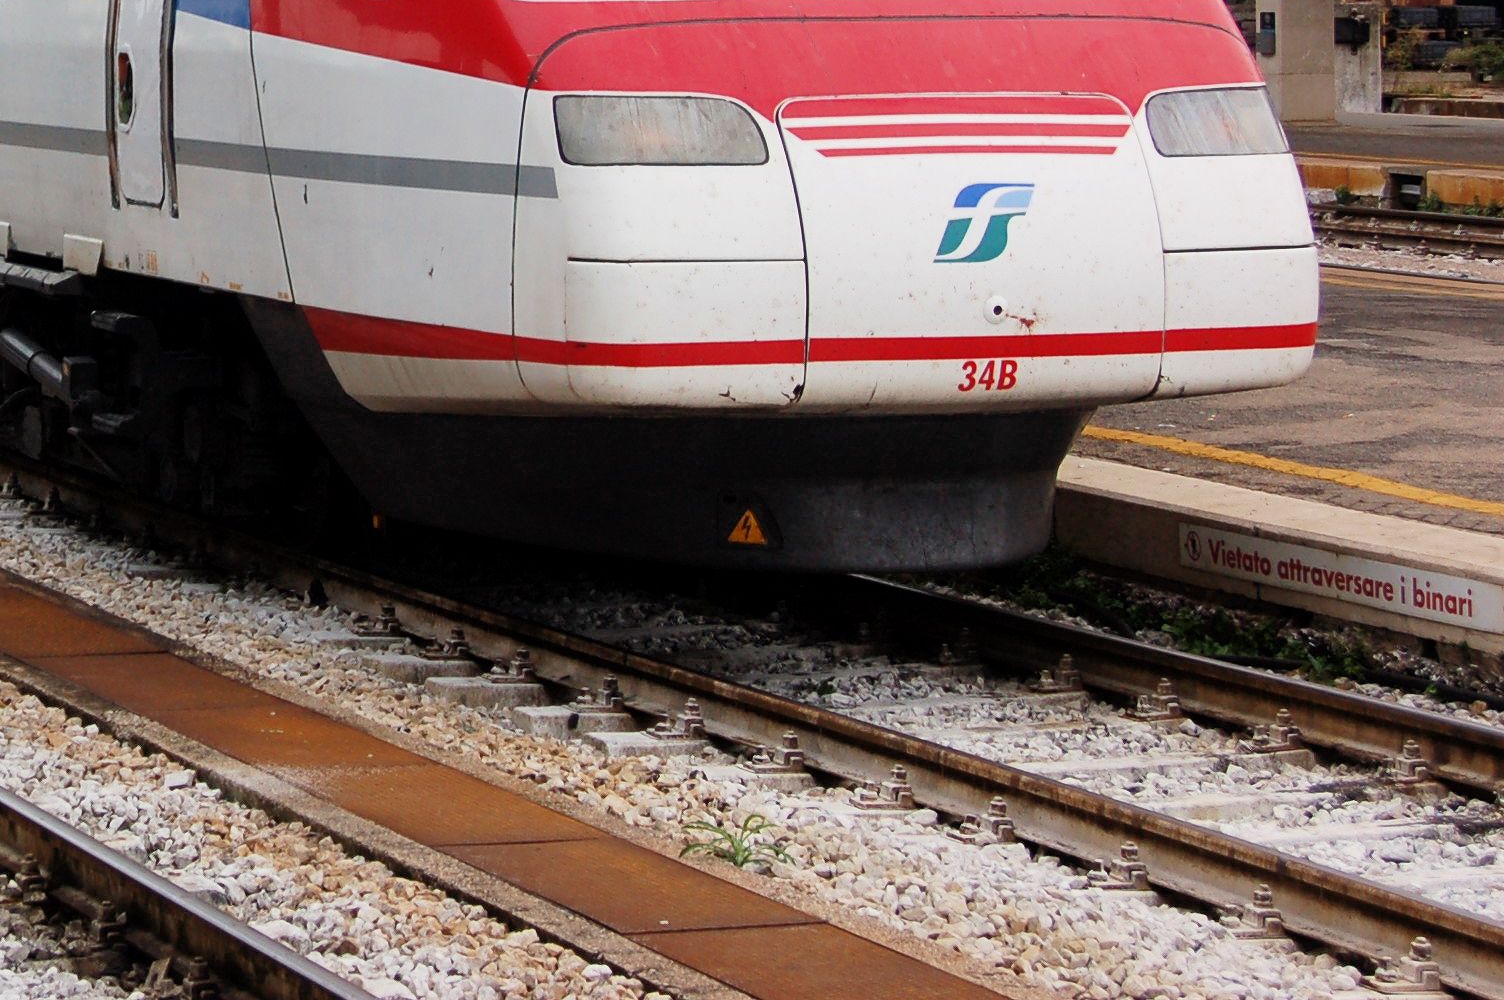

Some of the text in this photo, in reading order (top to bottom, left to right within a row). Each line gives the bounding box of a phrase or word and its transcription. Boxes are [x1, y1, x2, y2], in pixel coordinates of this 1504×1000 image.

[957, 360, 1018, 392] 34B
[1207, 538, 1473, 618] Vietato attraversare i binari
